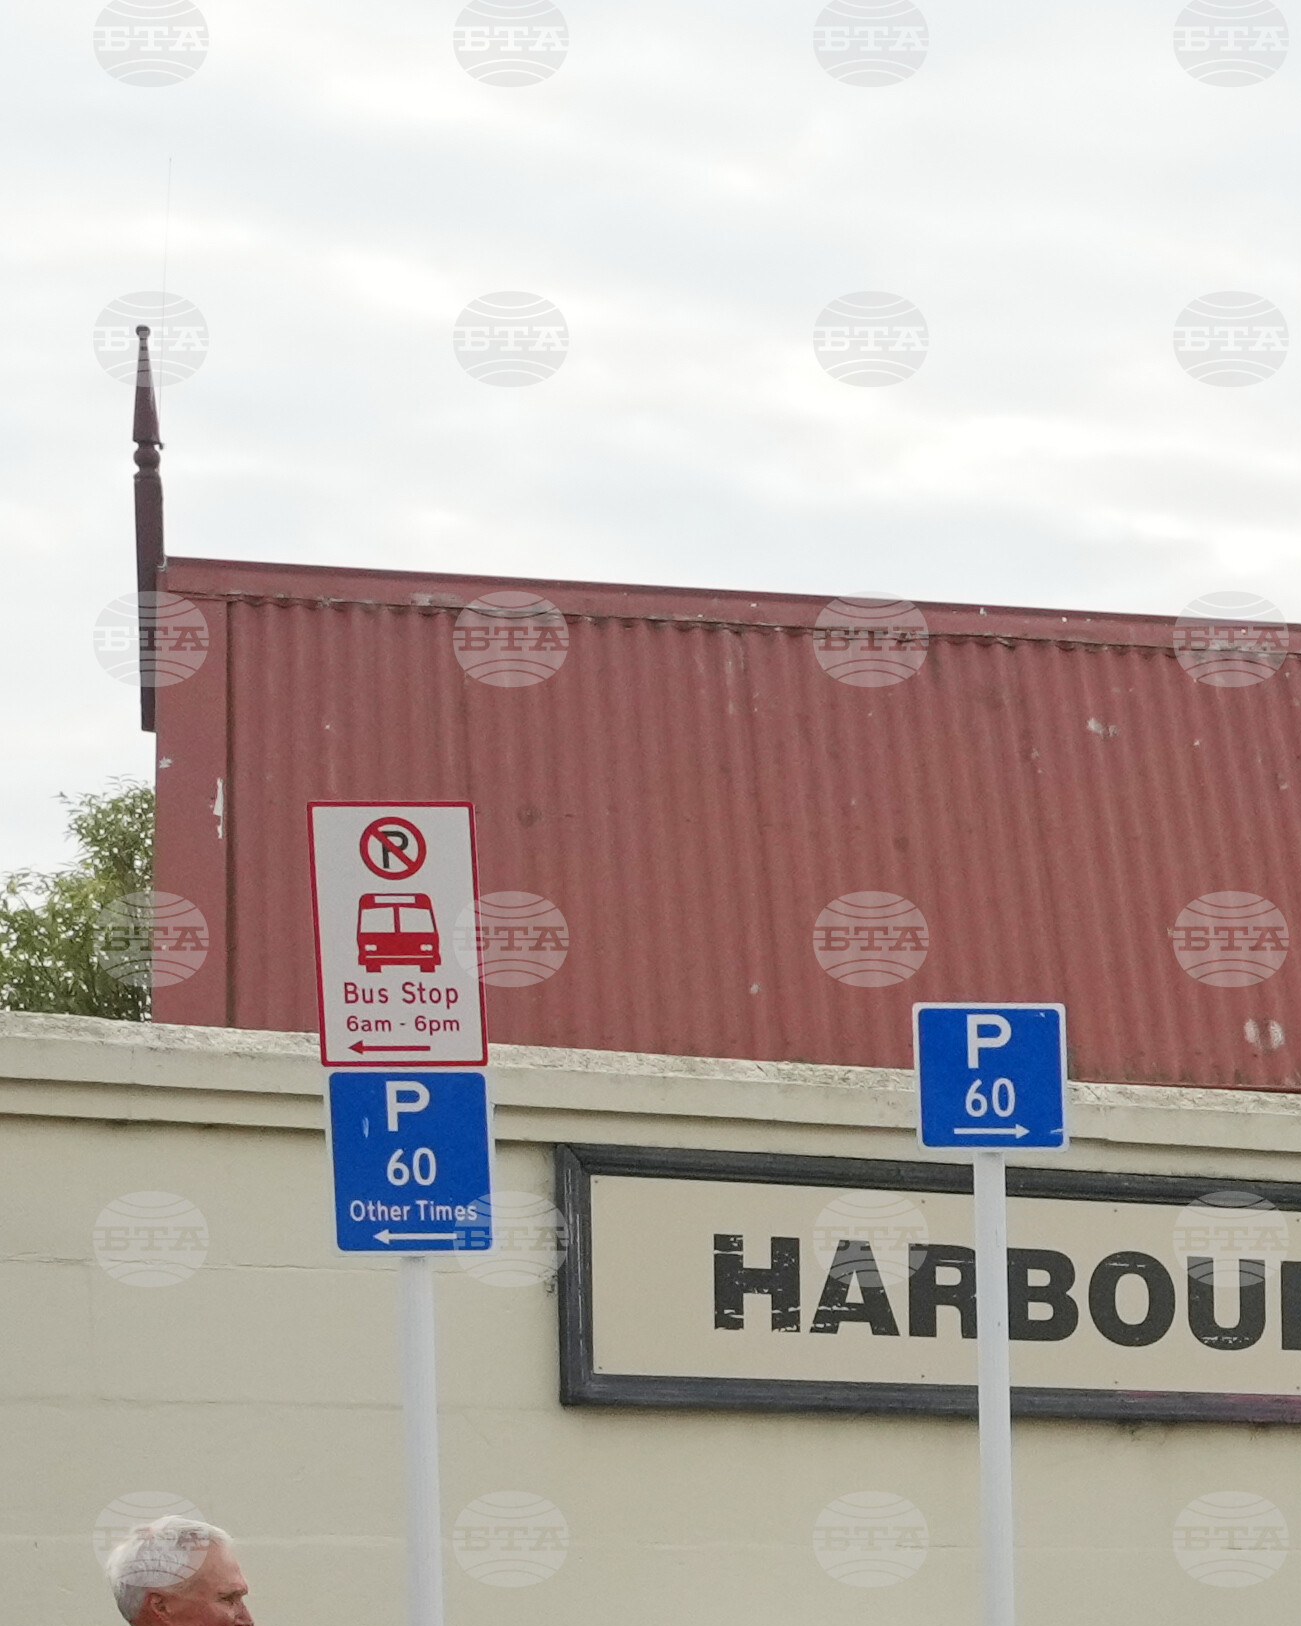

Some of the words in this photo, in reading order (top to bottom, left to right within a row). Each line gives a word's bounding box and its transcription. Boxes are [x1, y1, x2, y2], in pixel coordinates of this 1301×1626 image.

[344, 982, 389, 1004] Bus
[401, 981, 459, 1010] Stop
[346, 1015, 392, 1032] 6am
[414, 1015, 460, 1036] 6pm
[966, 1013, 1012, 1069] P
[385, 1080, 430, 1132] P
[965, 1077, 1016, 1117] 60
[386, 1147, 437, 1186] 60
[350, 1200, 411, 1222] Other
[415, 1200, 478, 1222] Times
